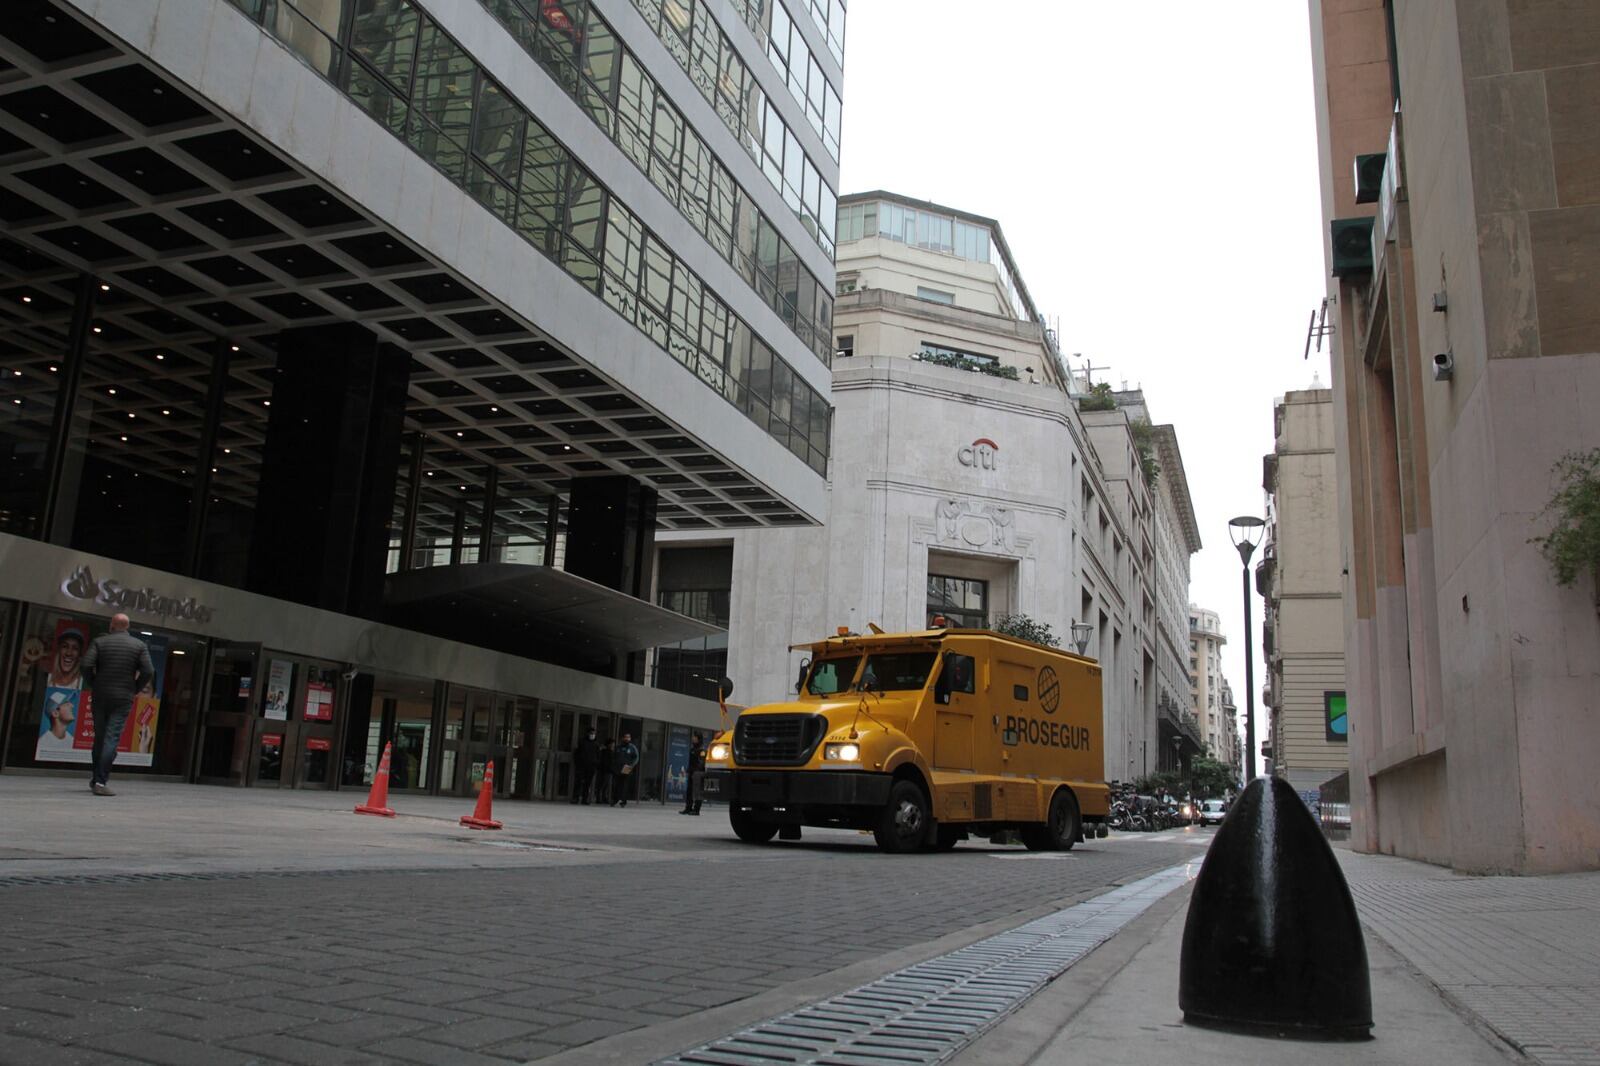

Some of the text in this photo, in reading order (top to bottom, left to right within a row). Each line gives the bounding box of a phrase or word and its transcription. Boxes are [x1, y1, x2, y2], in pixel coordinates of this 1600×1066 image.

[957, 438, 998, 471] citi
[96, 578, 215, 624] Santander
[1006, 714, 1090, 751] PROSEGUR
